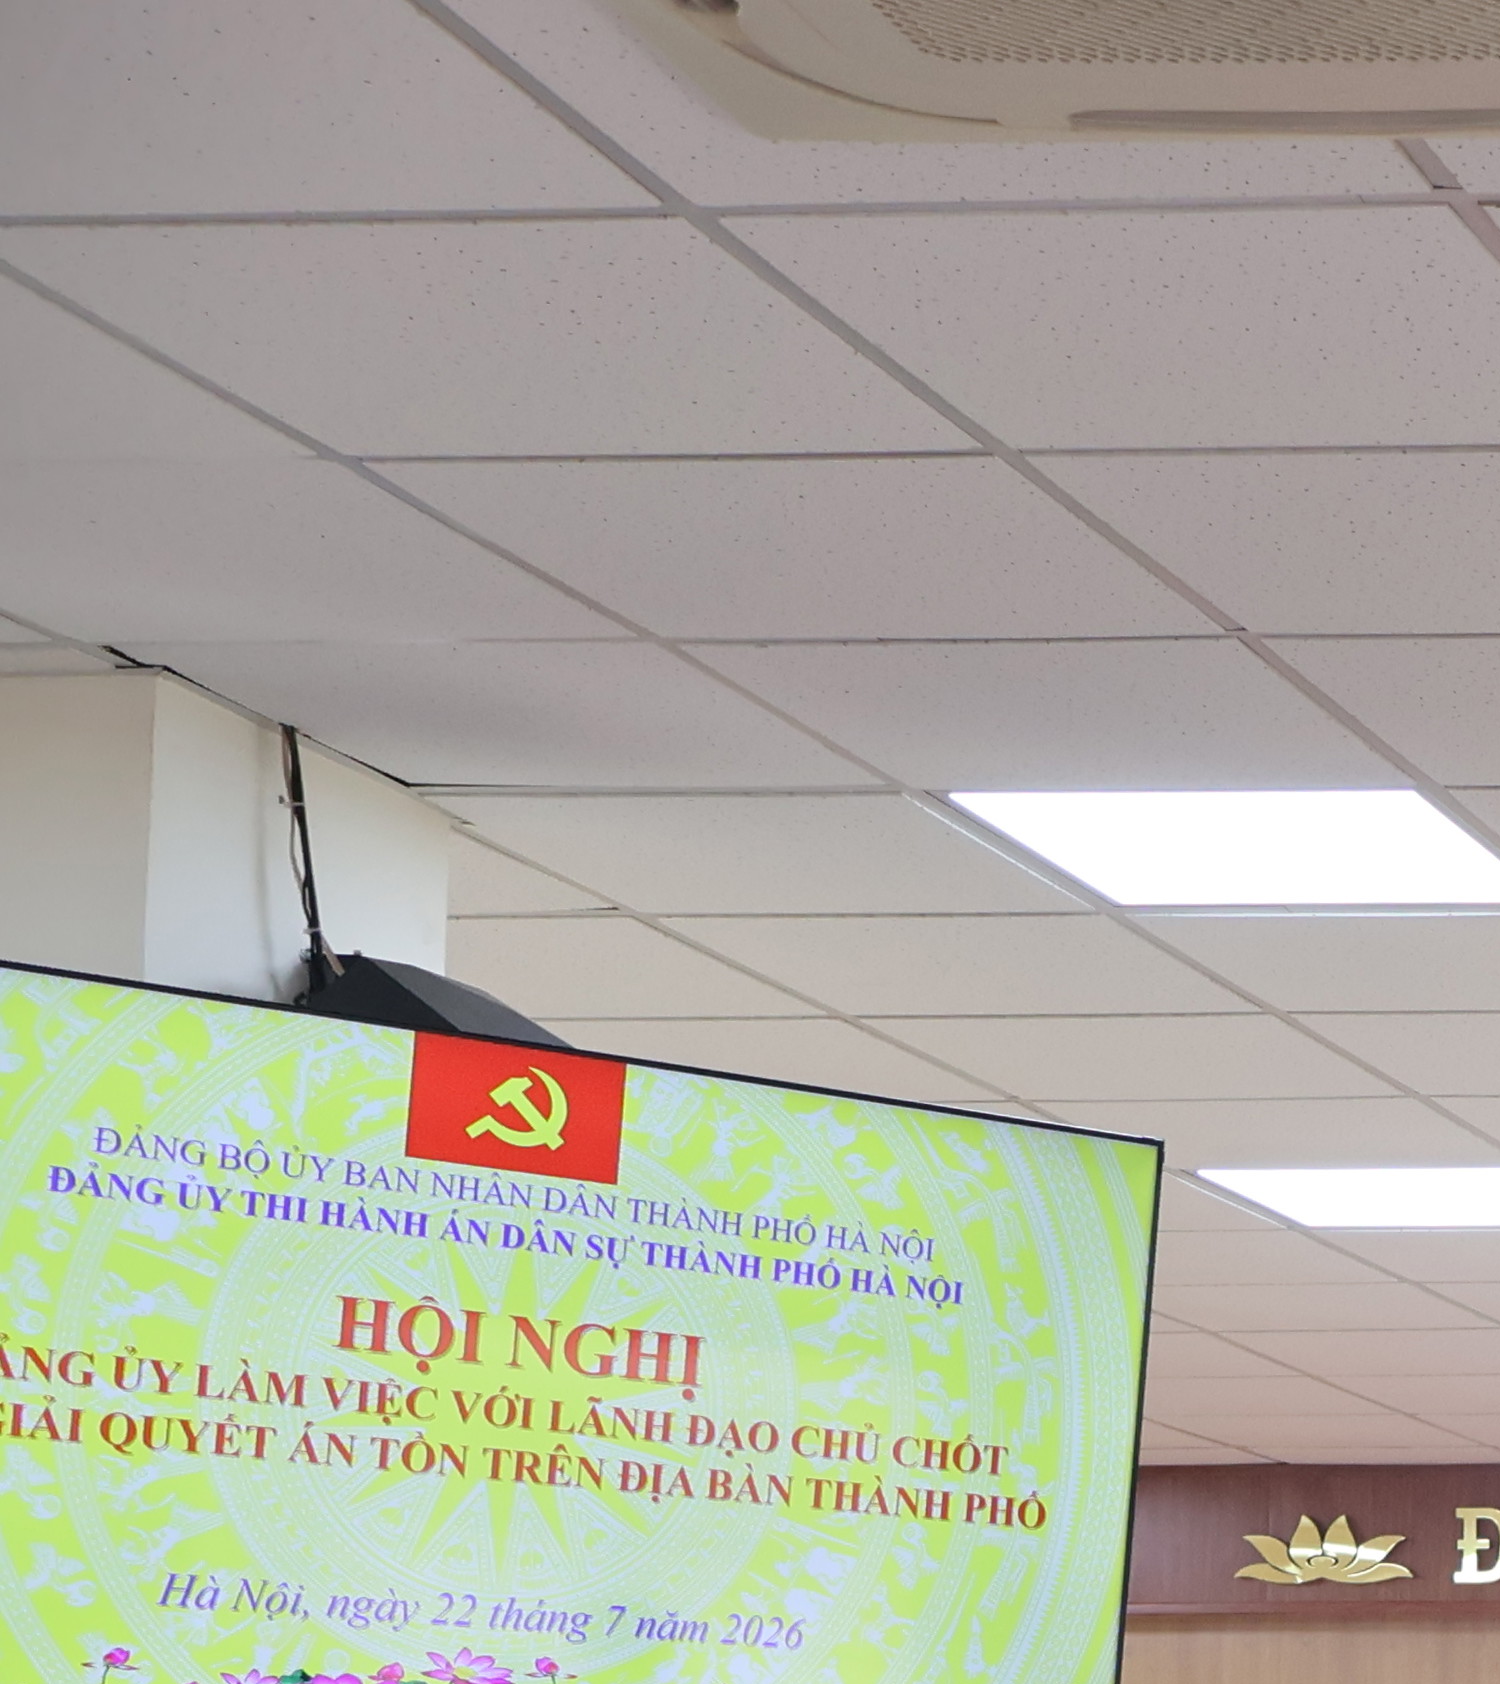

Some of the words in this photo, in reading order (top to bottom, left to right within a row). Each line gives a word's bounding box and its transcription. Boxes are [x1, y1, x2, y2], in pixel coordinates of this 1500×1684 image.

[334, 1295, 485, 1373] HỘI
[507, 1315, 705, 1395] NGHỊ
[156, 1572, 220, 1611] Hà
[231, 1577, 310, 1622] Nội,
[326, 1587, 420, 1632] ngày
[431, 1592, 477, 1628] 22
[489, 1596, 593, 1644] tháng
[605, 1604, 628, 1638] 7
[634, 1610, 709, 1643] năm
[720, 1613, 804, 1650] 2026
